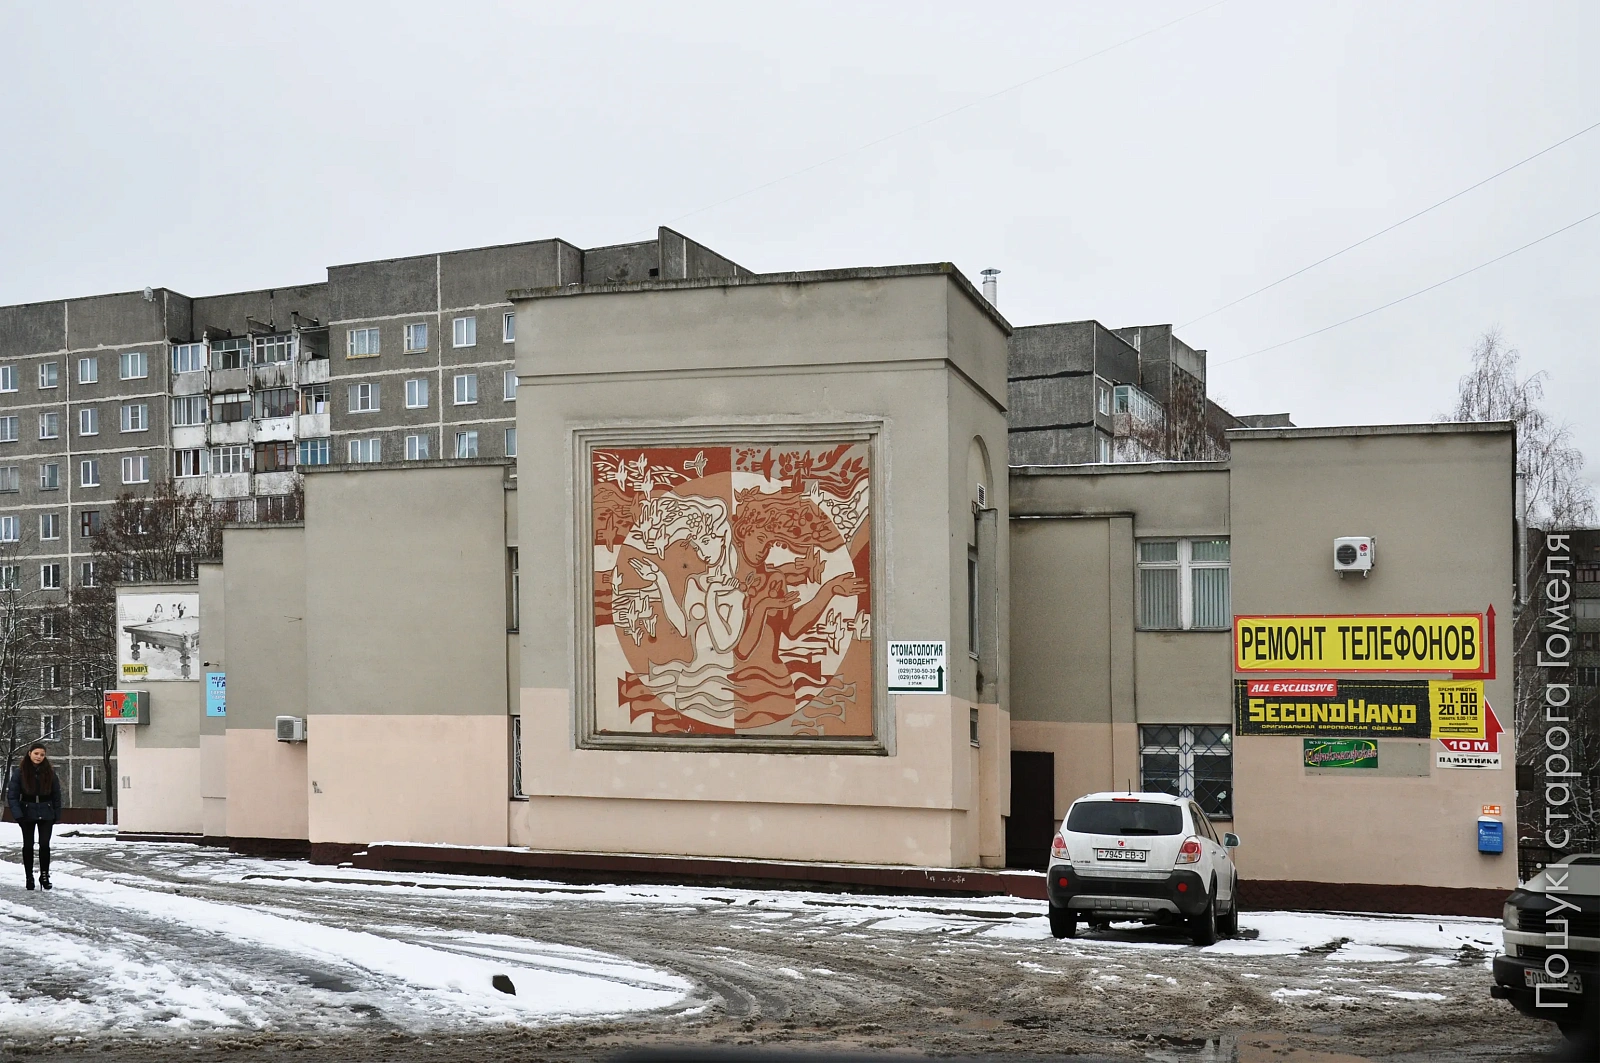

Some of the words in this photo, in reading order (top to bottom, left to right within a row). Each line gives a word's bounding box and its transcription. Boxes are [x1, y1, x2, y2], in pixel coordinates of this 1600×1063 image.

[1241, 626, 1326, 660] РЕМОНТ
[1338, 625, 1476, 661] ТЕЛЕФОНОВ
[890, 644, 943, 656] СТОМАТОЛОГИЯ
[1251, 684, 1270, 692] ALL
[1273, 684, 1334, 692] EXCLUSIVE
[1440, 692, 1477, 703] 11.00
[1438, 704, 1477, 715] 20.00
[1449, 741, 1471, 750] 10
